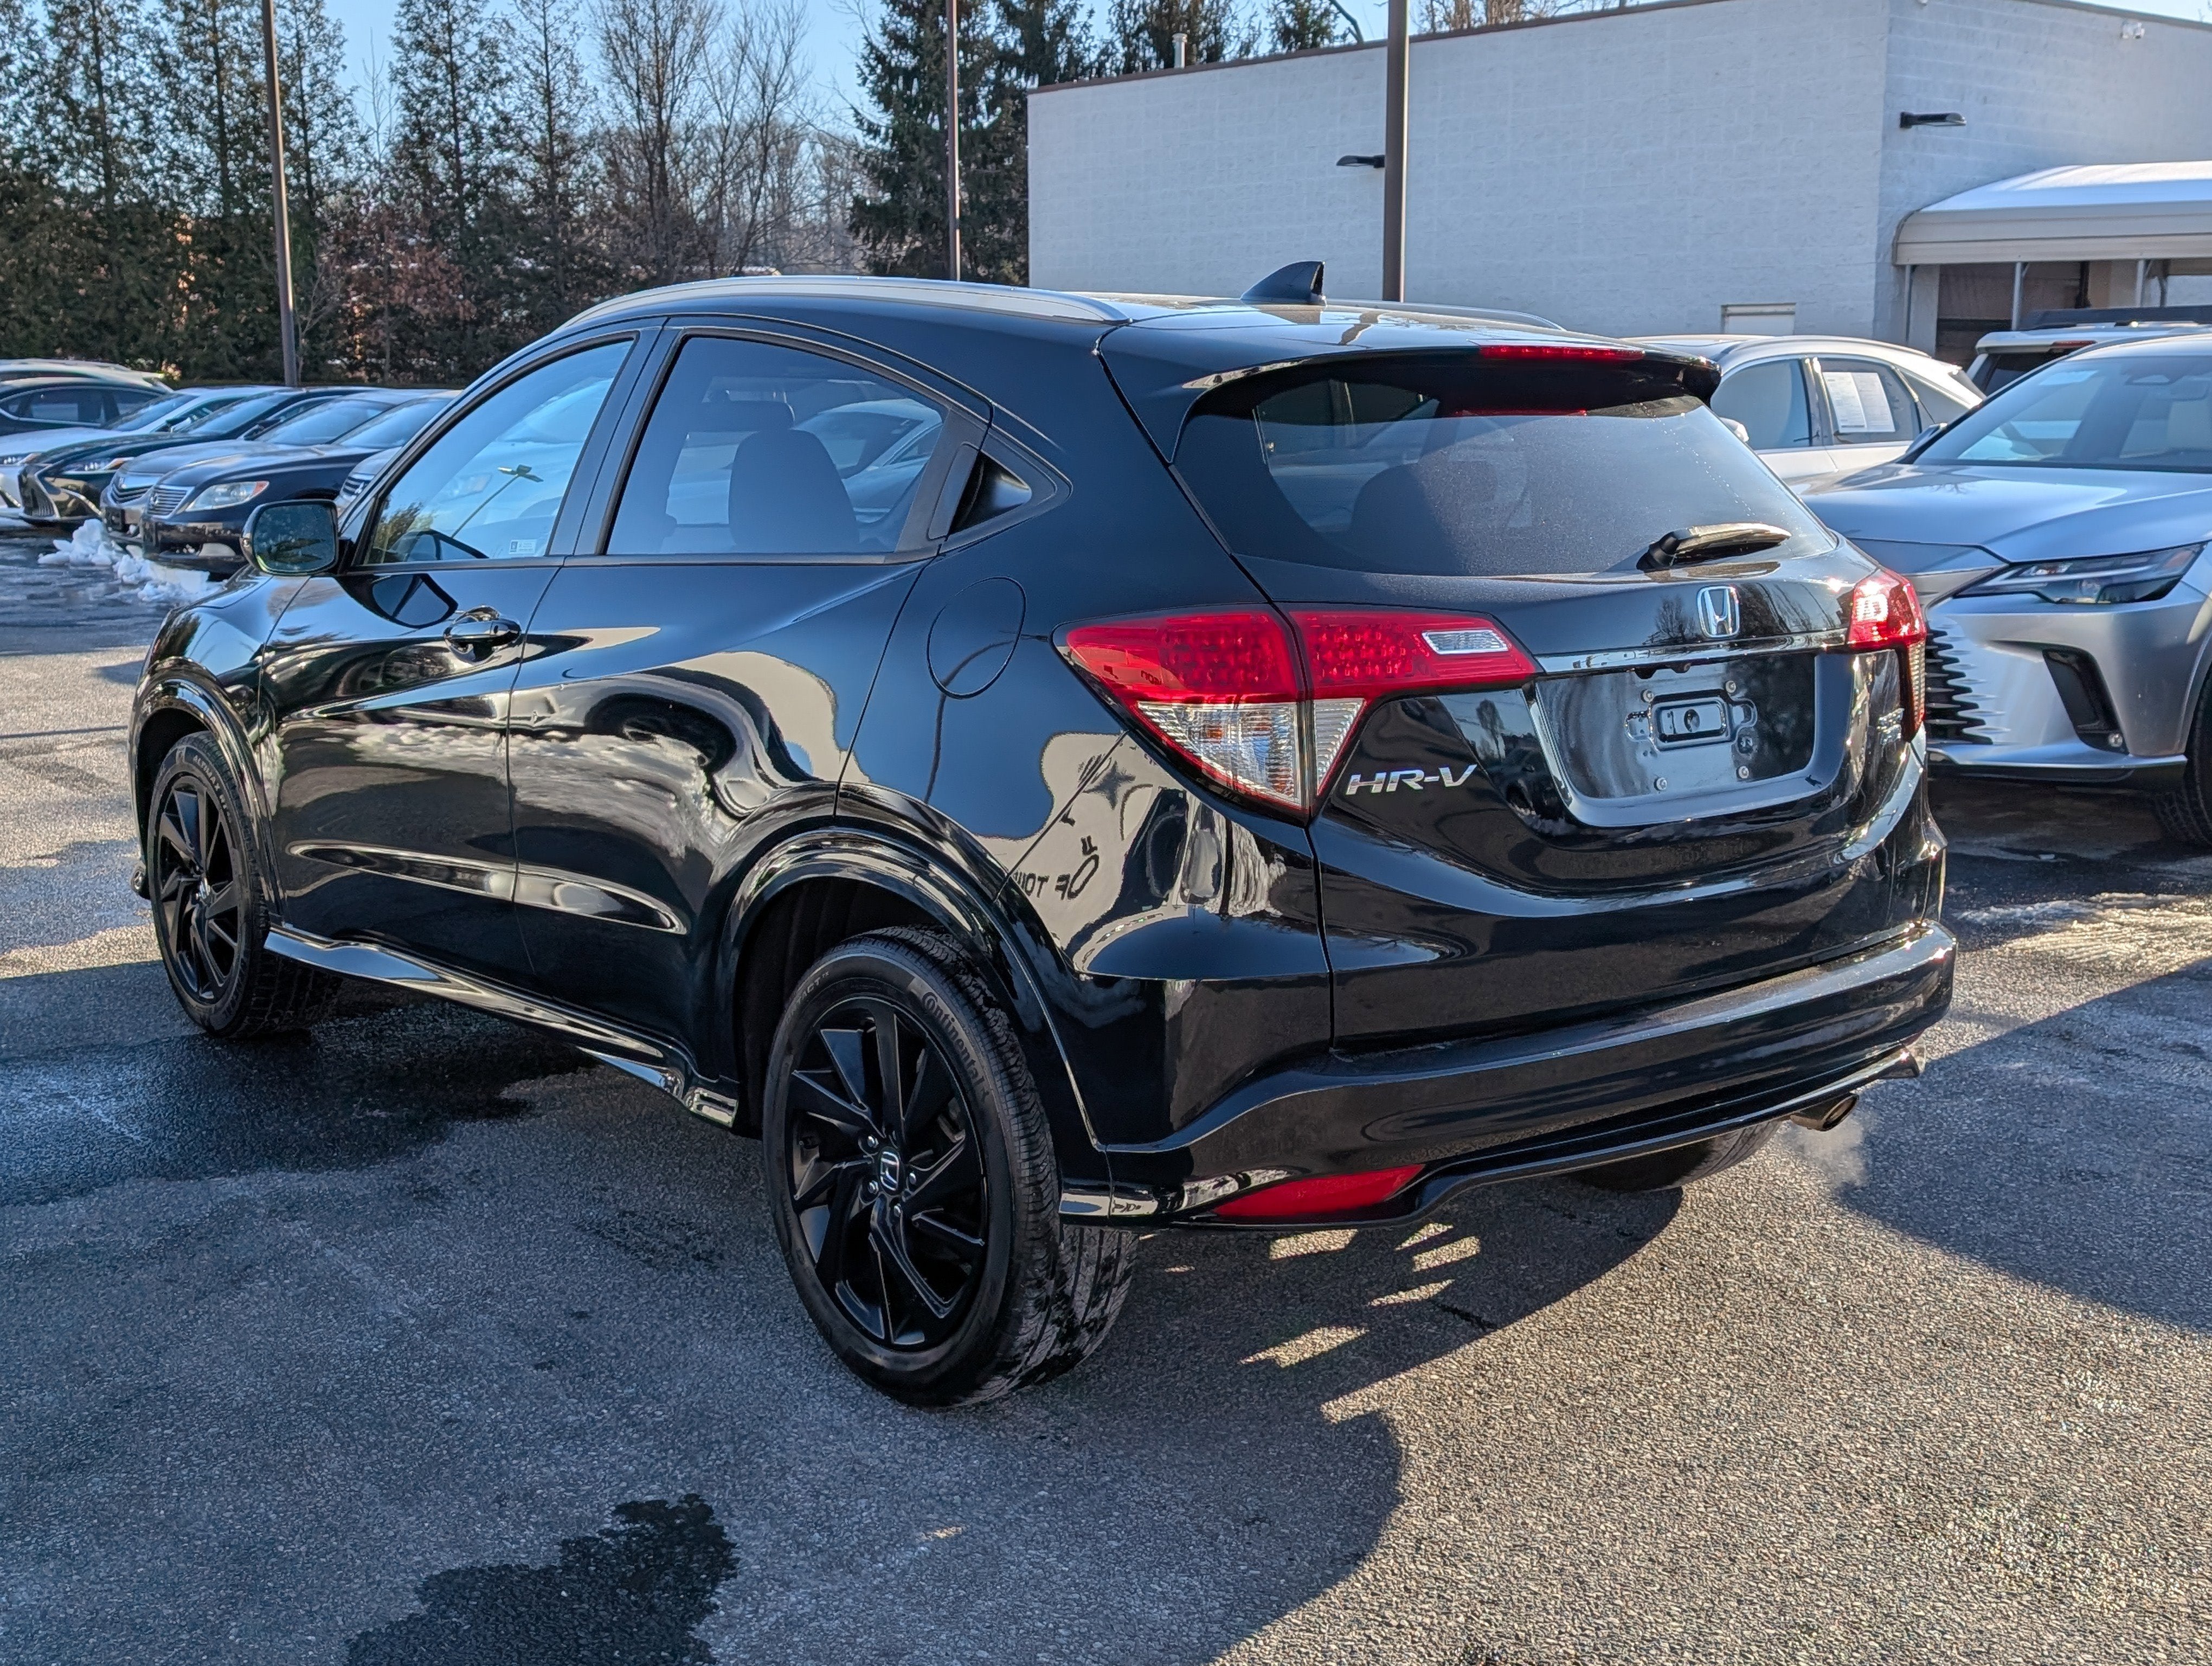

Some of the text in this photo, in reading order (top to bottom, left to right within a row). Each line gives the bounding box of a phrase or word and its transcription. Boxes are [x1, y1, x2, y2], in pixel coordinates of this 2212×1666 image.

[192, 754, 220, 792] ALTIMAX
[1345, 763, 1478, 796] HR-V
[922, 991, 985, 1087] Continental
